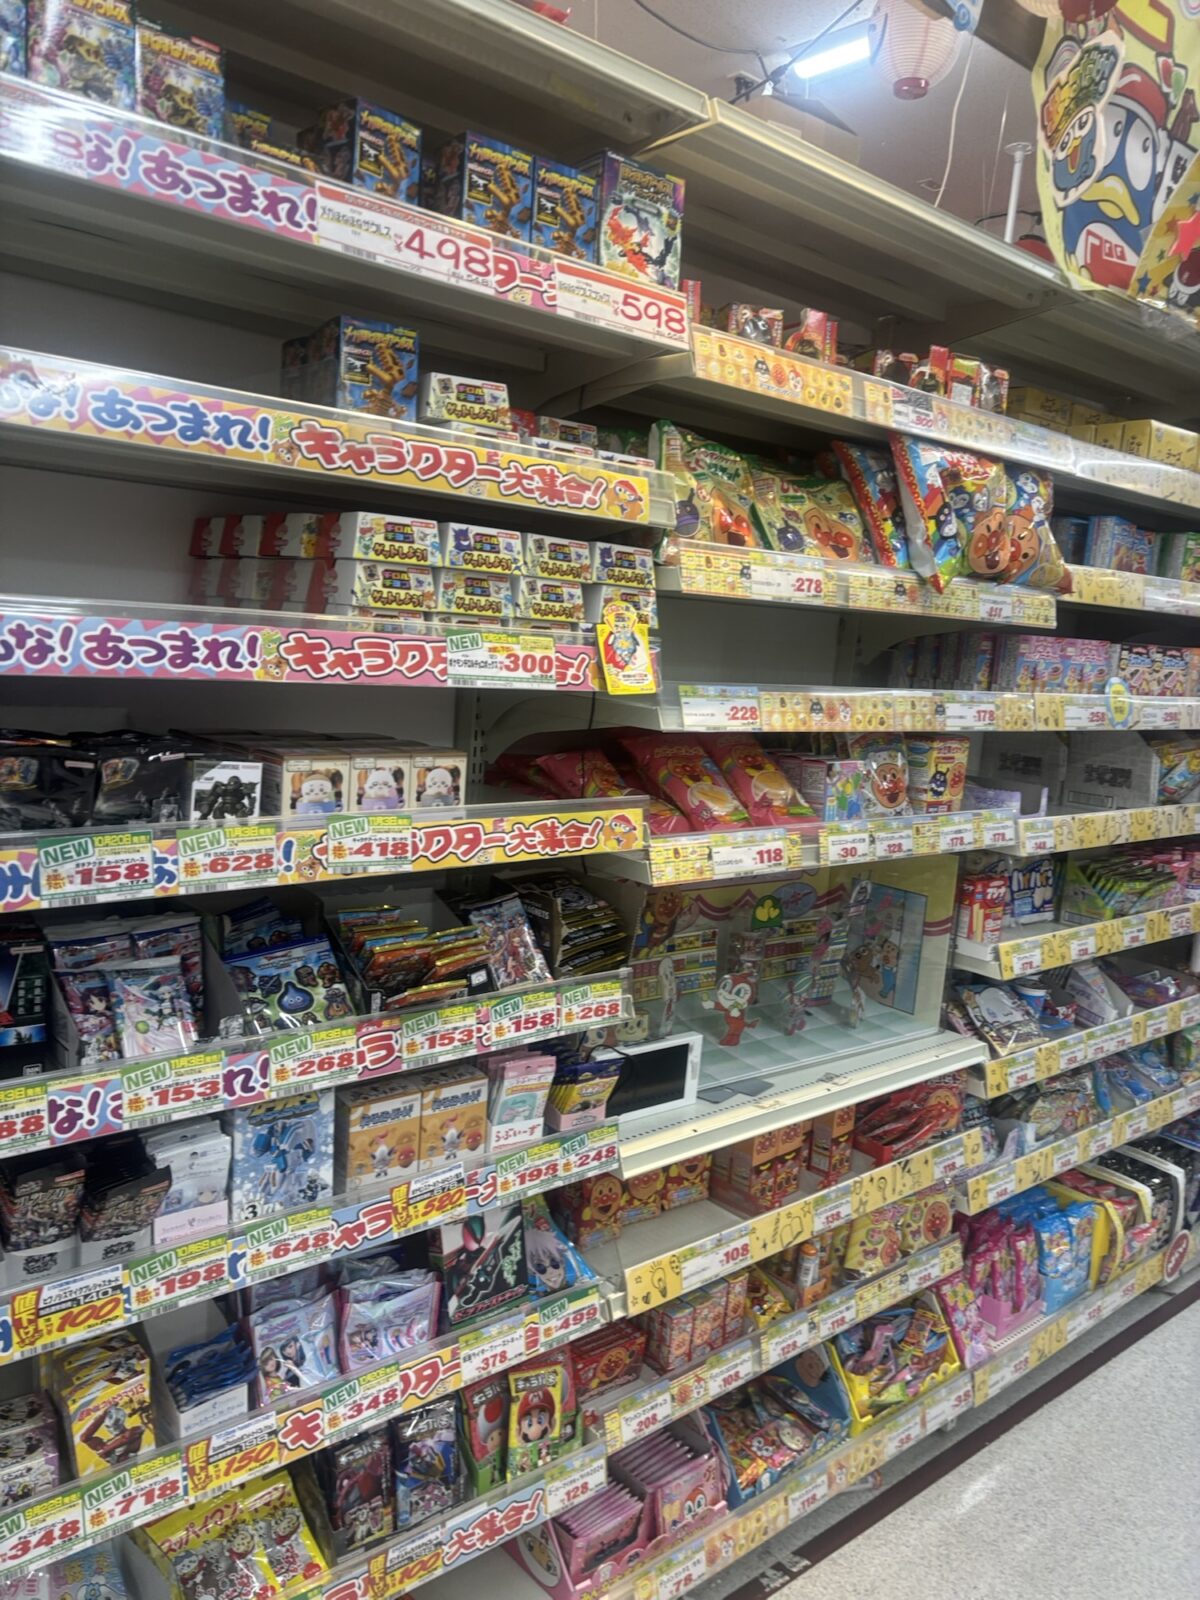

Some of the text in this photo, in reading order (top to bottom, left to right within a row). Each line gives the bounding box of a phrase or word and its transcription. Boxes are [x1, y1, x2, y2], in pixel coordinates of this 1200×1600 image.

[141, 149, 318, 234] あつまれ!
[88, 387, 272, 451] あつまれ!
[294, 424, 605, 508] キャラクター大集合!
[373, 543, 429, 562] ゲットしよう!
[796, 578, 823, 593] 278
[84, 626, 259, 670] あつまれ!
[449, 634, 481, 651] NEW
[504, 653, 554, 674] 300
[729, 706, 759, 721] 228
[331, 819, 366, 838] NEW
[412, 820, 602, 860] クター大集合!
[43, 838, 90, 865] NEW
[181, 831, 222, 854] NEW
[353, 841, 410, 857] 418
[841, 847, 857, 858] 30
[208, 853, 275, 874] 628
[756, 848, 783, 864] 118
[75, 863, 150, 885] 158
[564, 987, 589, 1006] NEW
[493, 999, 521, 1020] NEW
[580, 1003, 620, 1020] 268
[404, 1014, 436, 1035] NEW
[511, 1012, 555, 1032] 158
[273, 1037, 309, 1061] NEW
[425, 1028, 475, 1050] 153
[296, 1052, 355, 1077] 268
[126, 1062, 168, 1091] NEW
[153, 1079, 221, 1106] 153
[562, 1135, 586, 1156] NEW
[577, 1145, 617, 1168] 248
[500, 1153, 527, 1175] NEW
[517, 1162, 559, 1186] 198
[249, 1220, 285, 1247] NEW
[271, 1232, 330, 1259] 648
[722, 1244, 750, 1264] 108
[133, 1252, 173, 1284] NEW
[161, 1262, 226, 1295] 198
[55, 1297, 122, 1333] 100
[541, 1300, 567, 1322] NEW
[557, 1306, 598, 1330] 499
[481, 1350, 509, 1371] 378
[326, 1381, 358, 1410] NEW
[347, 1388, 399, 1421] 348
[223, 1441, 277, 1478] 150
[87, 1472, 129, 1506] NEW
[115, 1479, 180, 1517] 718
[565, 1481, 589, 1502] 128
[446, 1491, 543, 1562] 大集合!
[7, 1519, 81, 1561] 348
